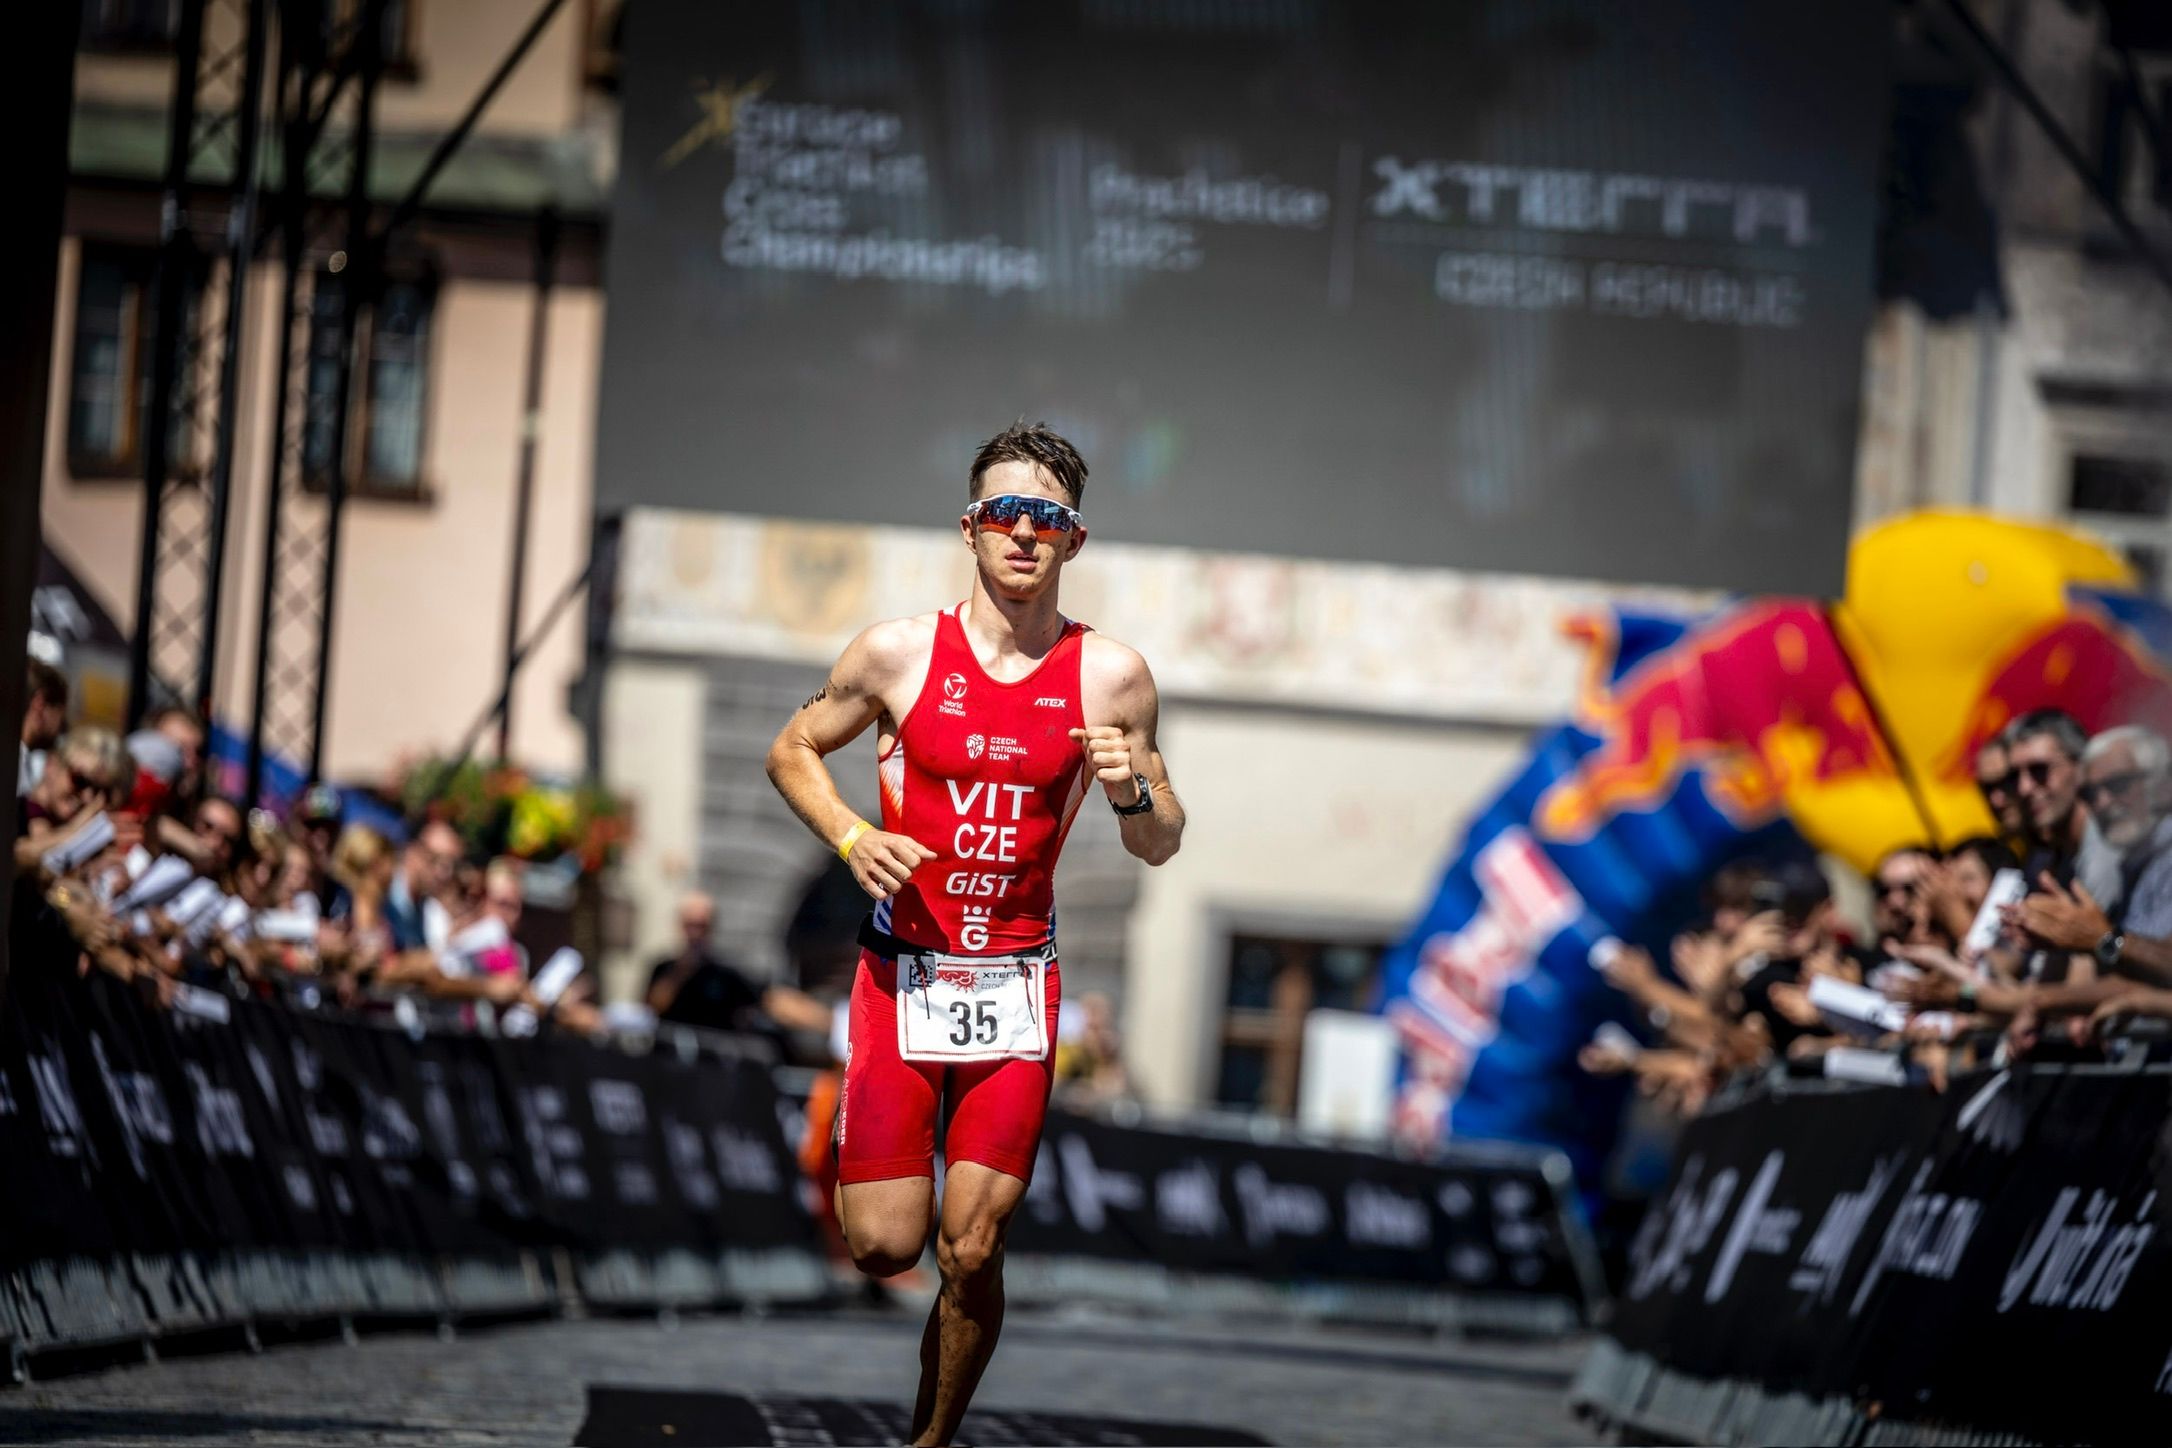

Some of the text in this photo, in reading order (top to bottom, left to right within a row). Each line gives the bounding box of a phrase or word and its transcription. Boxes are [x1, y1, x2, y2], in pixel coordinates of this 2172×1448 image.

[943, 699, 963, 710] World
[1034, 698, 1066, 708] ATEX
[939, 705, 966, 717] Triathlon
[990, 737, 1017, 746] CZECH
[989, 745, 1028, 755] NATIONAL
[988, 753, 1010, 761] TEAM
[946, 779, 1035, 820] VIT
[954, 822, 1017, 863] CZE
[982, 971, 1024, 979] XTERR
[949, 1000, 998, 1046] 35
